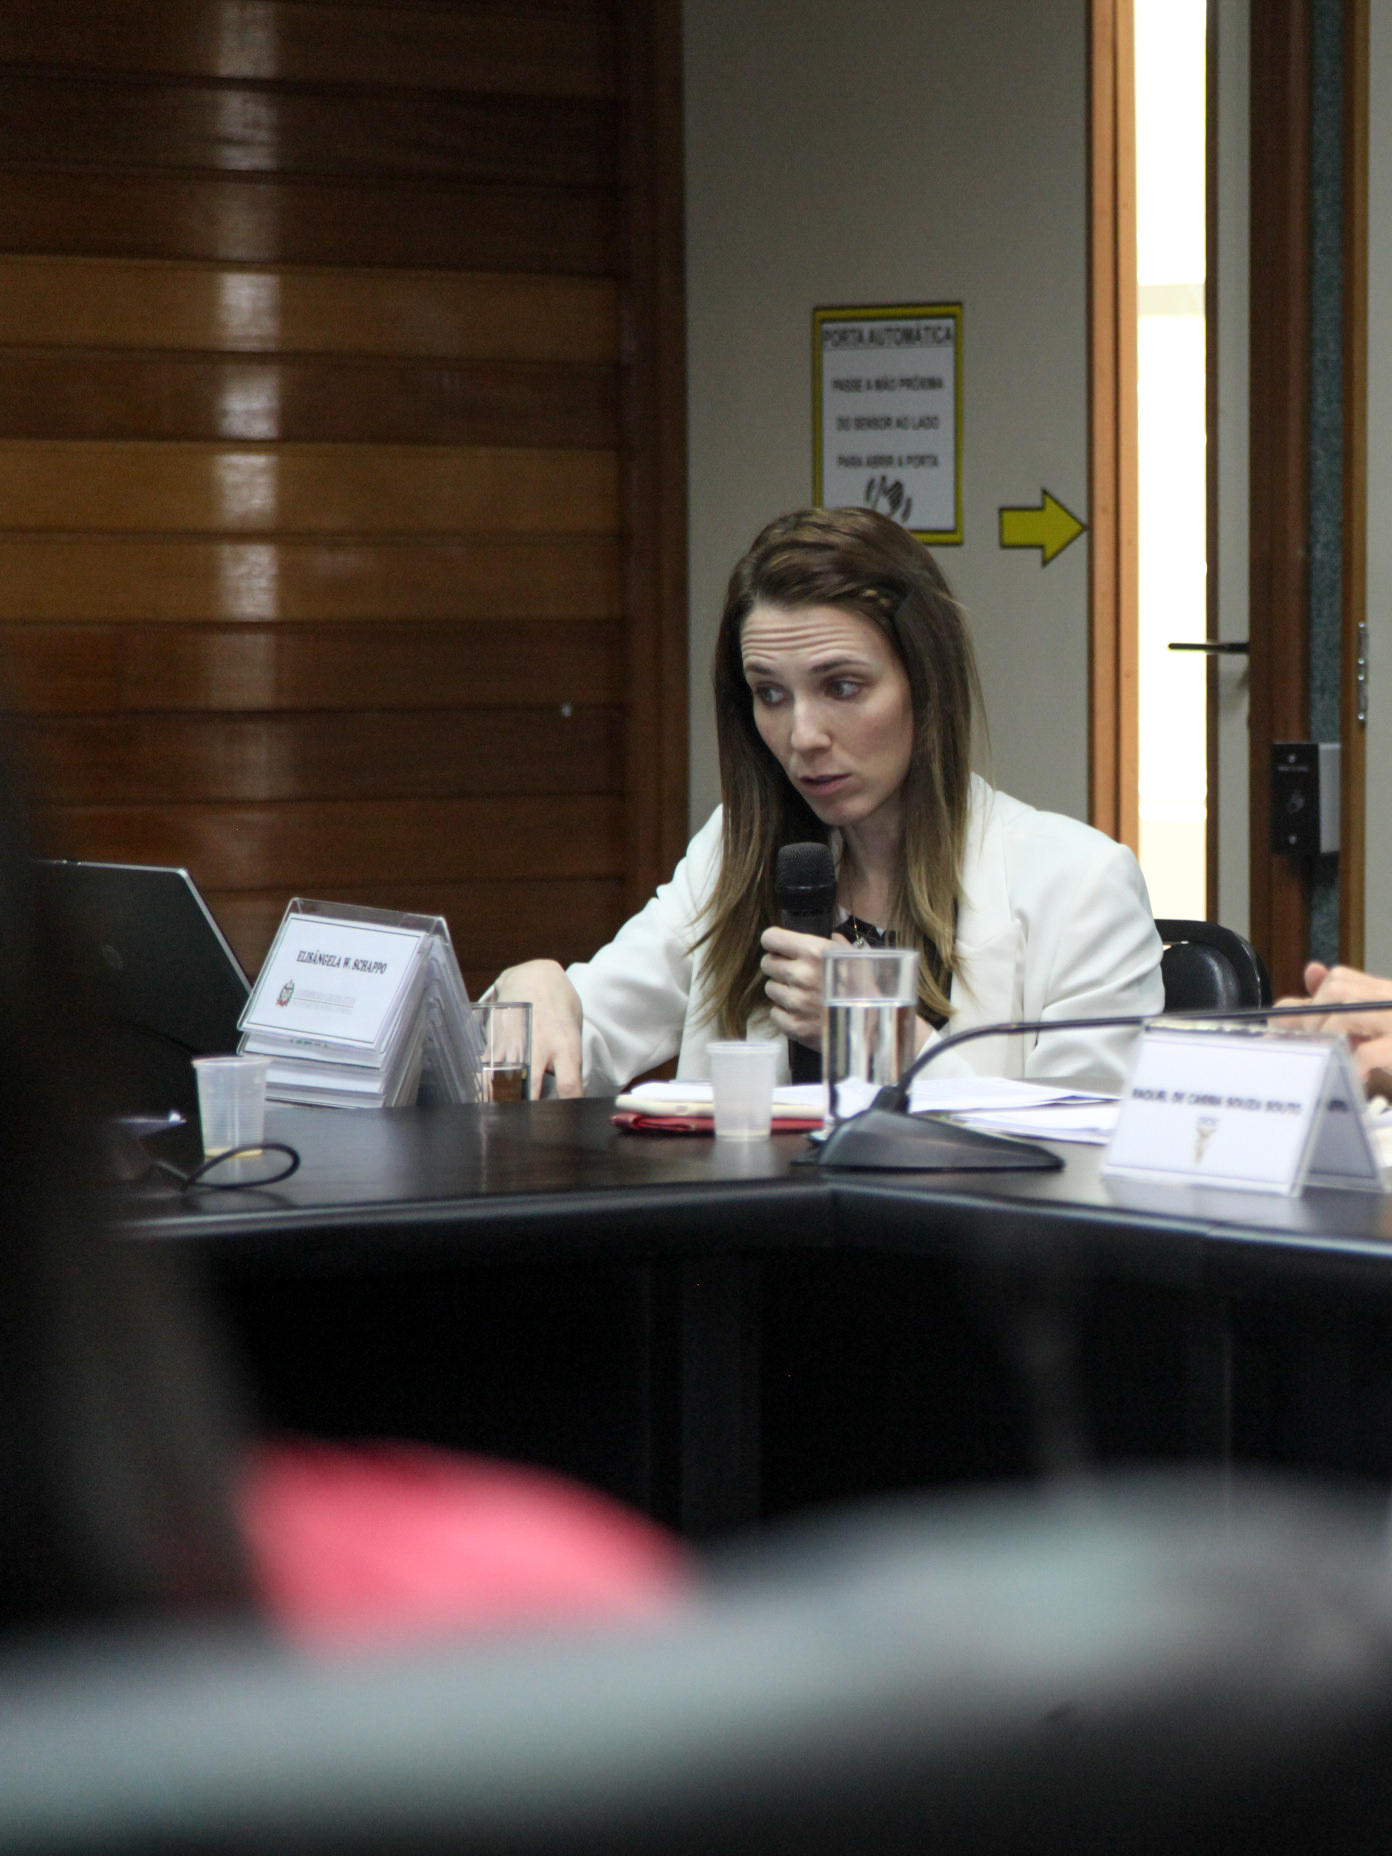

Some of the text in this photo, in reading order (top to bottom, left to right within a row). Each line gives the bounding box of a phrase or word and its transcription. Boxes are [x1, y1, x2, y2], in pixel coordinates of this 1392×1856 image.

[823, 328, 864, 347] PORTA
[854, 416, 893, 431] SENSOR
[896, 416, 910, 430] AO
[912, 415, 940, 430] LADO
[906, 454, 938, 468] PORTA
[352, 958, 388, 974] SCHAPPO
